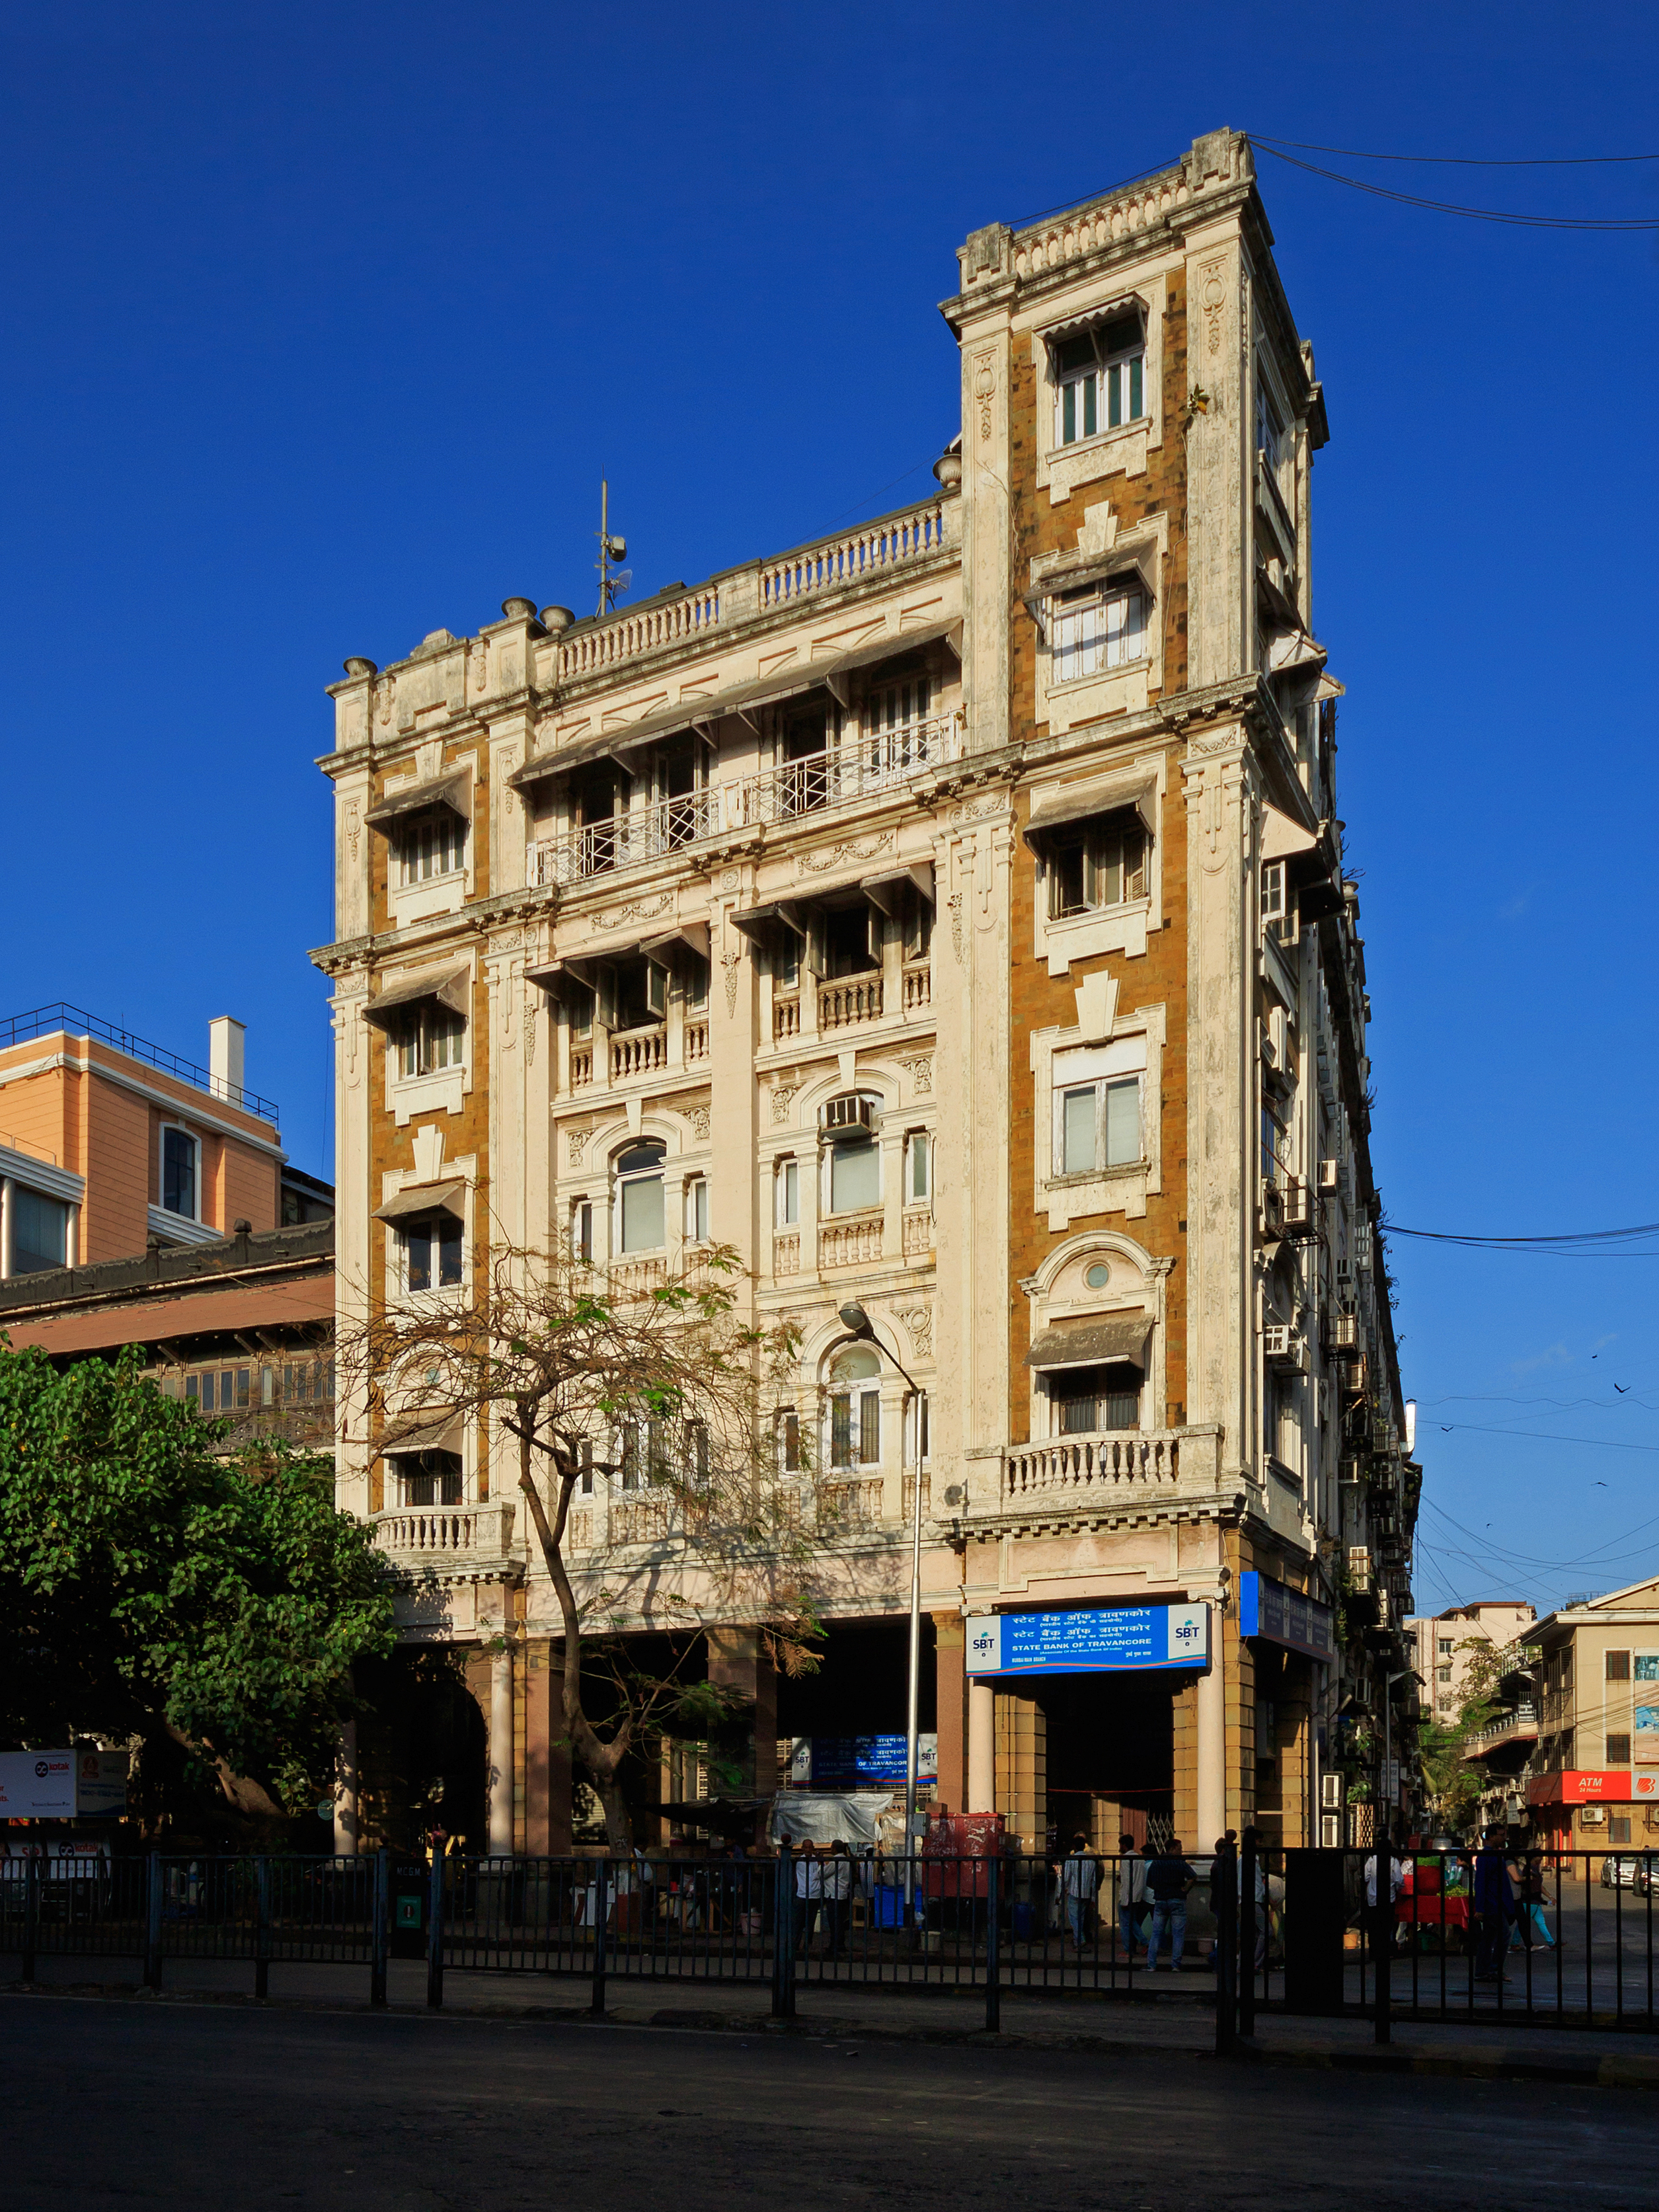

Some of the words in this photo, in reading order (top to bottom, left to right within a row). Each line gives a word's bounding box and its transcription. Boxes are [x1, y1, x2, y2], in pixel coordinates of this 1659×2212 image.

[1098, 1608, 1151, 1618] त्रावणकोर
[1099, 1624, 1151, 1633] त्रावणकोर
[1175, 1627, 1200, 1638] SBT
[973, 1638, 995, 1649] SBT
[1087, 1638, 1151, 1647] TRAVANCORE
[1578, 1778, 1602, 1786] ATM
